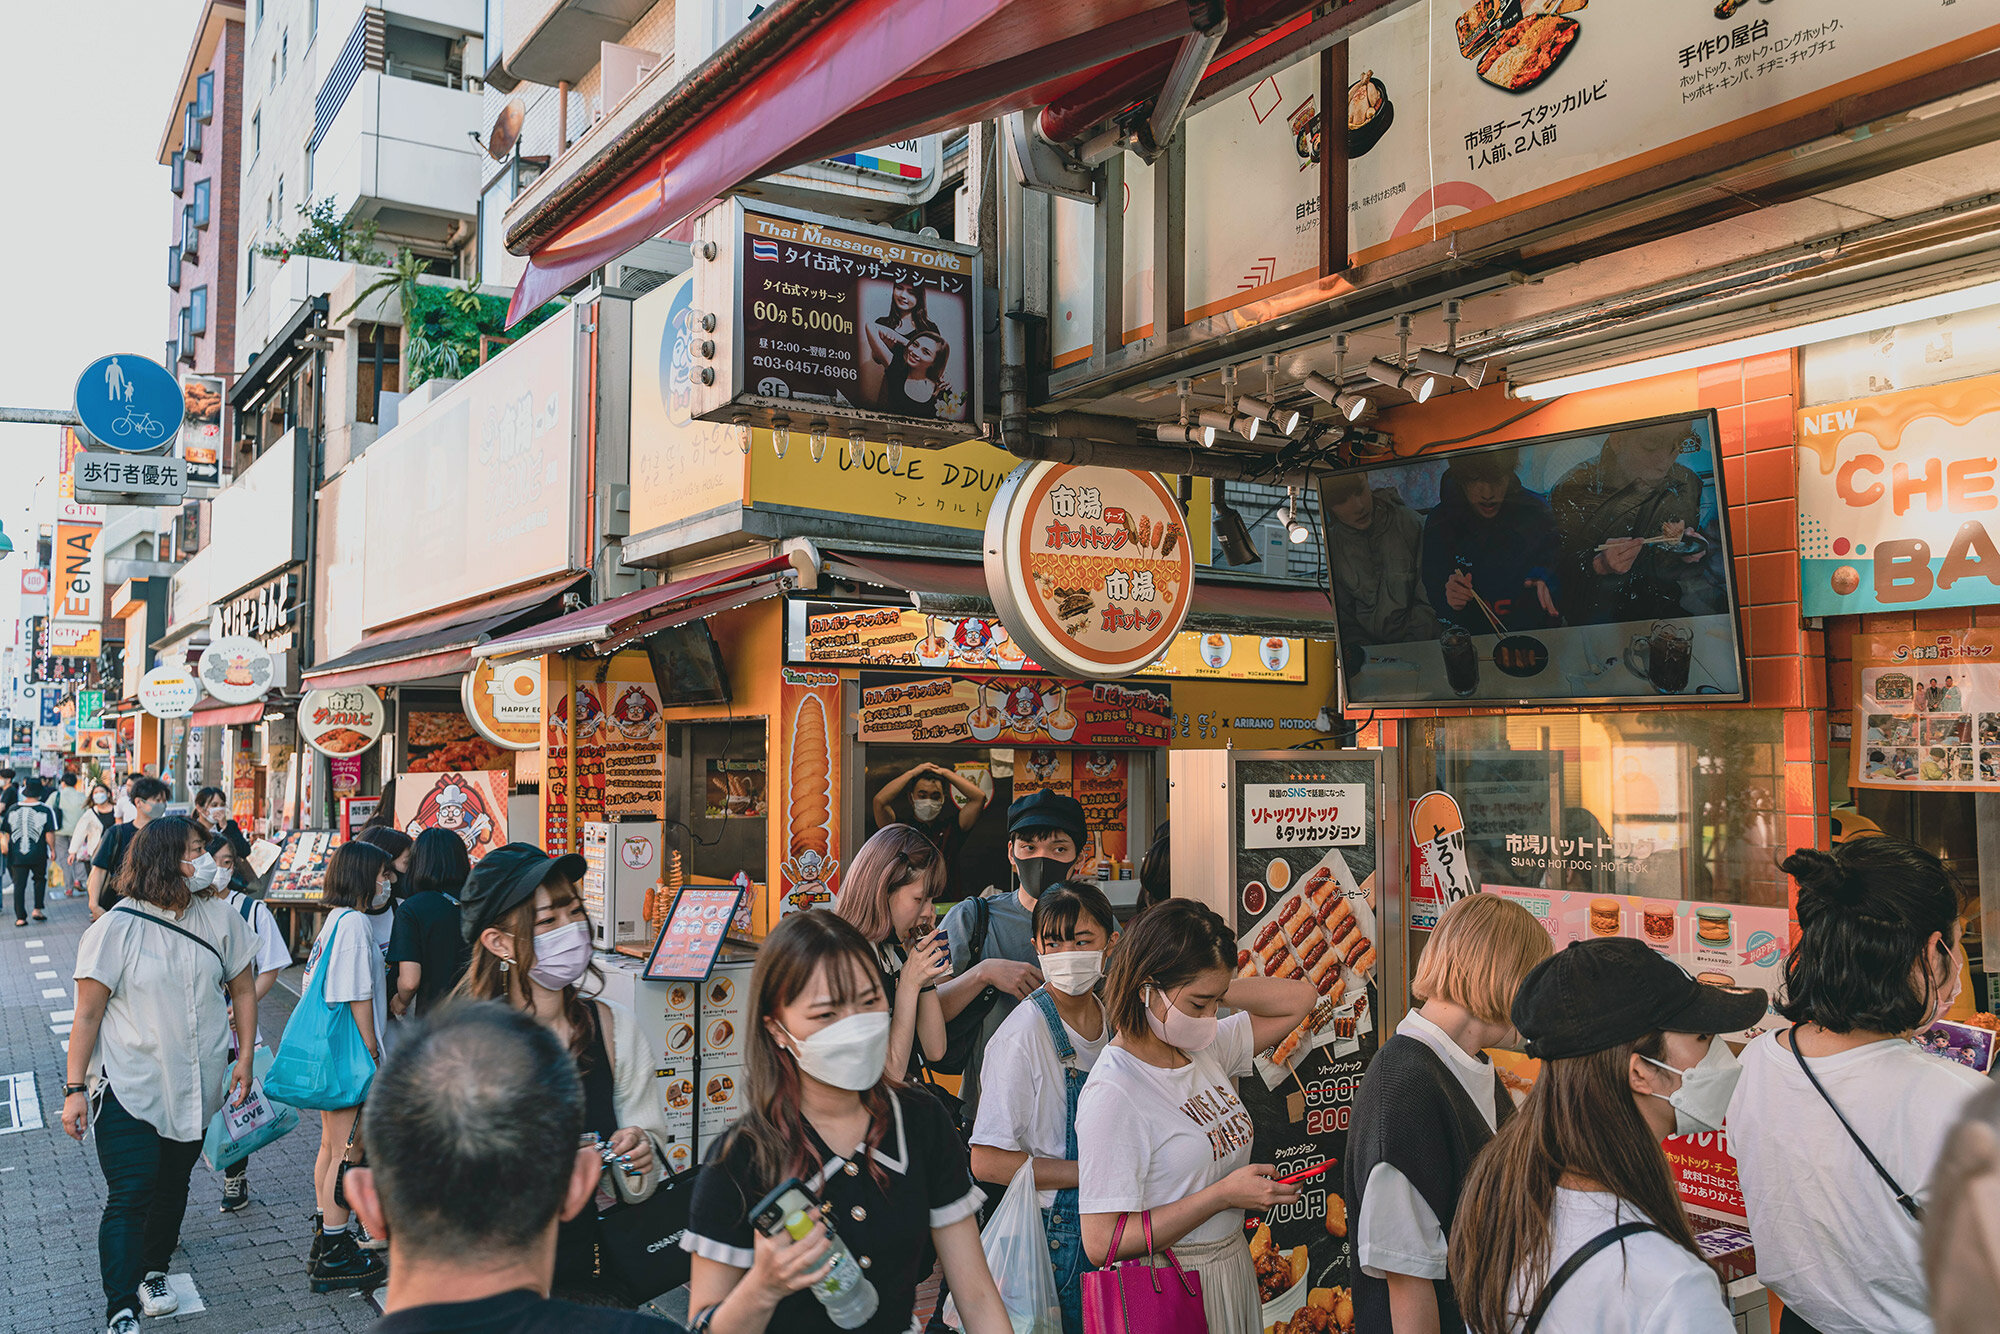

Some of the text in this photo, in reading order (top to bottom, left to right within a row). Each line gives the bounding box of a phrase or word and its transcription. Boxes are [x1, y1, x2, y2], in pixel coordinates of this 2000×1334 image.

[1678, 18, 1770, 69] 手作り屋台
[1463, 79, 1609, 152] 市場チーズタッカルビ
[1466, 123, 1558, 171] 1人前、2人前
[757, 220, 961, 271] Thai Massage SI TONG
[785, 247, 964, 294] タイ古式マッサージ シートン
[763, 278, 847, 303] タイ古式マッサージ
[753, 301, 853, 335] 60分 5,000円
[770, 340, 800, 354] 12:00
[828, 348, 851, 361] 2:00
[1803, 408, 1858, 437] NEW
[84, 462, 178, 487] 歩行者優先
[1836, 453, 1999, 517] CHE
[65, 505, 97, 516] GTN
[1049, 484, 1126, 522] 市場 チーズ
[1104, 568, 1156, 602] 市場
[1100, 602, 1163, 633] ホットク
[55, 628, 80, 637] GTN
[1911, 645, 1939, 660] 市場
[805, 673, 838, 687] Potato
[328, 692, 364, 711] 市場
[312, 707, 374, 727] タッカルビ
[1085, 709, 1133, 724] 魅力的な味!
[1233, 717, 1274, 730] ARIRANG
[911, 723, 968, 741] カルボナーラ!
[606, 790, 662, 805] カルボナーラ!
[1268, 787, 1346, 798] 韓国のSNSで話題になった
[1251, 807, 1339, 824] ソトックソトック
[1276, 825, 1361, 842] &タッカンジョン
[1548, 859, 1567, 870] HOT
[1570, 860, 1592, 871] DOG
[1332, 888, 1371, 900] ソーセージ
[1411, 914, 1438, 927] SECO
[1318, 1061, 1362, 1075] ソトックソトック
[233, 1104, 265, 1129] LOVE
[1275, 1143, 1317, 1158] タッカンジョン
[1675, 1181, 1746, 1208] 協力ありがとう
[646, 1228, 686, 1254] CHANE
